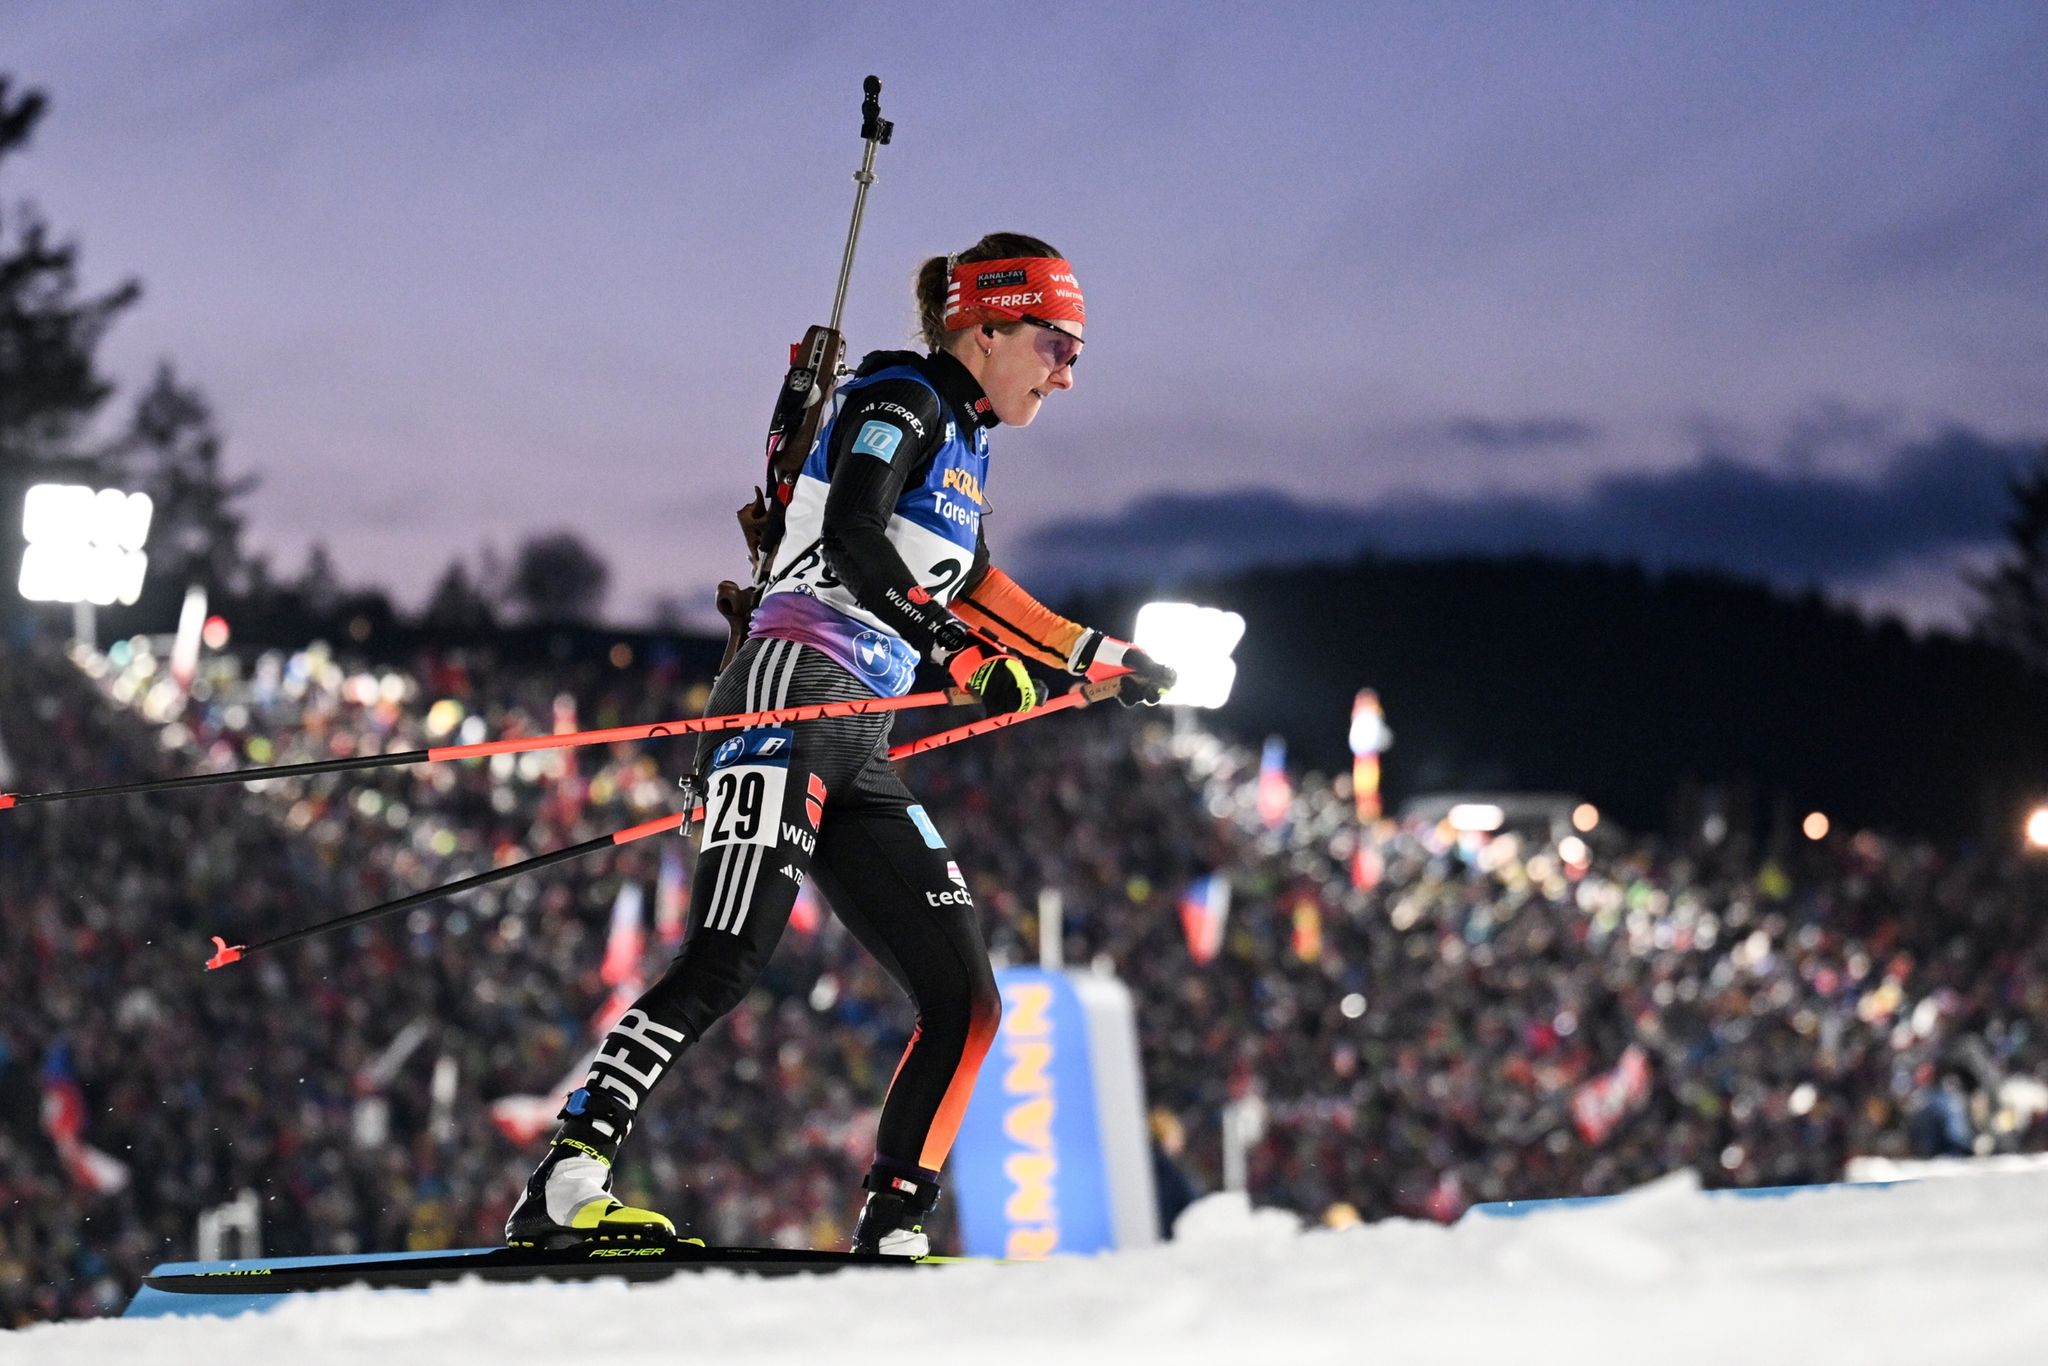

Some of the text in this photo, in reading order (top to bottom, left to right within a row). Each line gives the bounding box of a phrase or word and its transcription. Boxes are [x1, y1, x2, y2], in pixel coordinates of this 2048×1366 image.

[978, 270, 1024, 281] KANAL-FAY
[982, 292, 1043, 307] TERREX
[878, 401, 925, 438] TERREX
[863, 425, 893, 455] TQ
[710, 771, 765, 842] 29
[584, 1008, 685, 1137] GER
[560, 1138, 611, 1168] FISCHE
[588, 1247, 666, 1257] FISCHER
